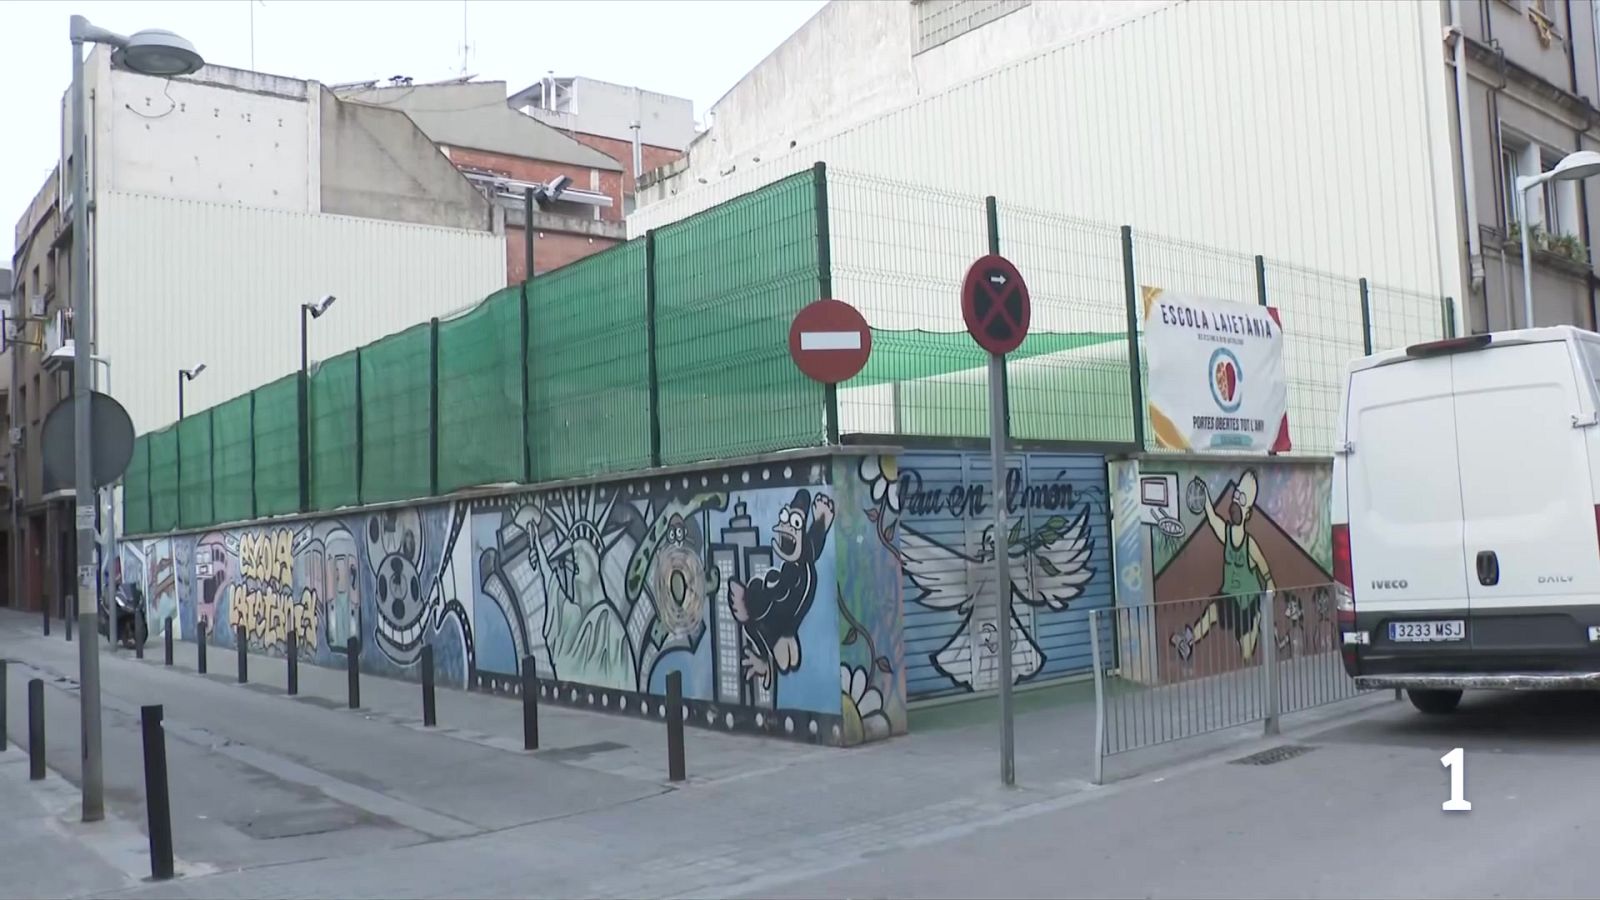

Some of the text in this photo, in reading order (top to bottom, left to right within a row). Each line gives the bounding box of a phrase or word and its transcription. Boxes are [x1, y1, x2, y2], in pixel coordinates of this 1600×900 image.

[1160, 304, 1209, 330] ESCOLA
[1212, 312, 1272, 339] LAIETÀNIA
[1193, 415, 1214, 430] PORTES
[1215, 416, 1239, 431] OBERTES
[1371, 580, 1408, 590] IVECO
[1537, 575, 1573, 584] DAILY
[1398, 623, 1463, 638] 3233 MSJ
